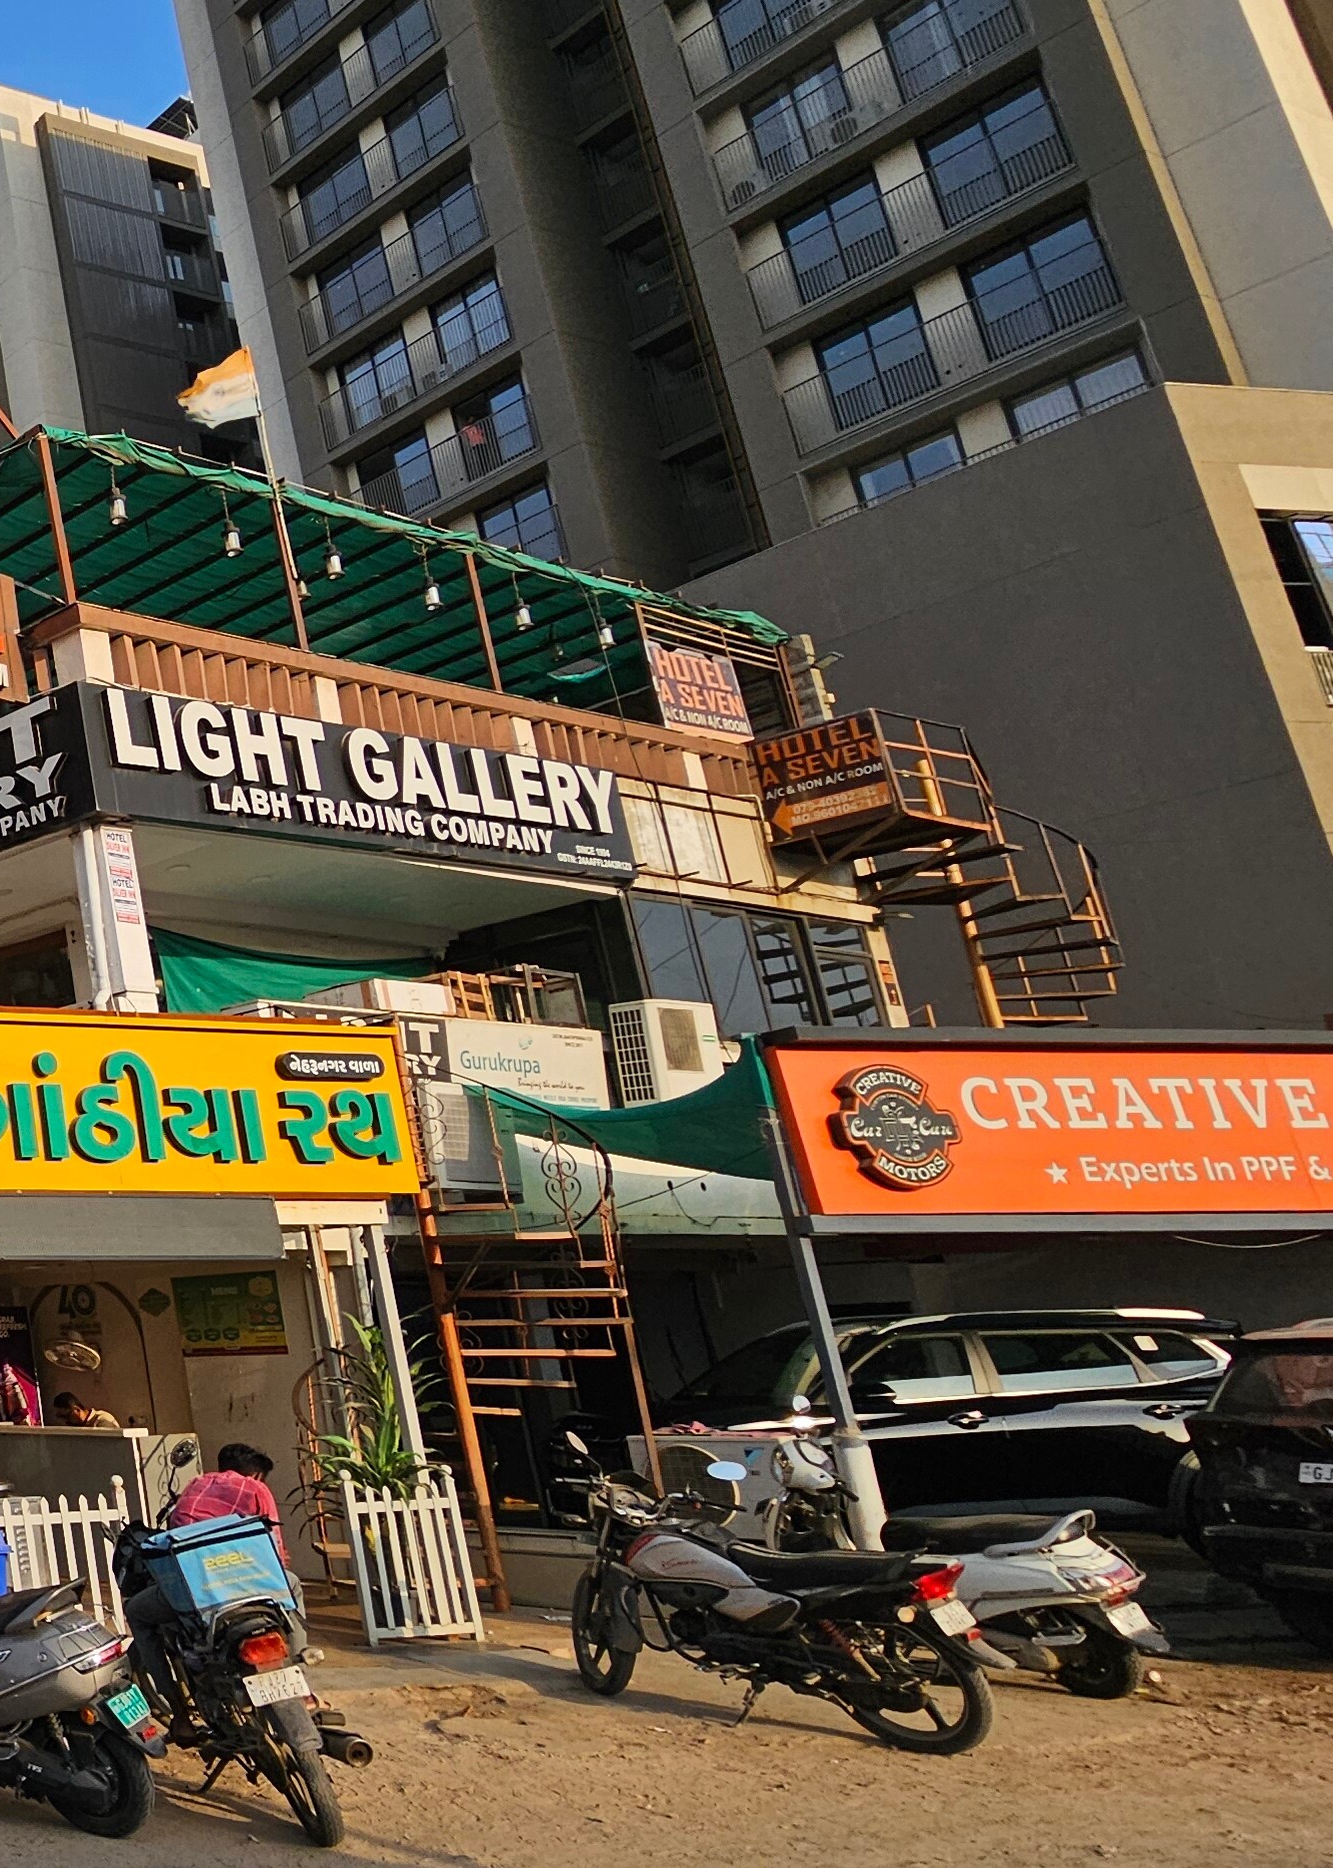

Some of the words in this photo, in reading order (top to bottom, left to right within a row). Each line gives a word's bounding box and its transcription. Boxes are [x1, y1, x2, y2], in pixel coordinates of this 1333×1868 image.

[653, 650, 733, 693] HOTEL
[659, 679, 675, 704] A
[677, 683, 745, 719] SEVEN
[723, 717, 748, 734] ROOM
[755, 717, 872, 766] HOTEL
[105, 687, 325, 792] LIGHT
[345, 726, 614, 836] GALLERY
[762, 768, 780, 788] A
[788, 738, 882, 780] SEVEN
[765, 781, 786, 801] A/C
[786, 785, 796, 796] &
[797, 777, 823, 793] NON
[825, 770, 846, 788] A/C
[846, 762, 884, 779] ROOM
[106, 832, 127, 844] HOTEL
[210, 782, 292, 819] LABH
[296, 794, 425, 836] TRADING
[430, 812, 554, 856] COMPANY
[112, 878, 134, 889] HOTEL
[348, 1057, 381, 1076] વાળા
[460, 1050, 541, 1078] Gurukrupa
[855, 1071, 922, 1095] CREATIVE
[960, 1077, 1330, 1131] CREATIVE
[278, 1089, 404, 1165] રથ
[879, 1156, 947, 1181] MOTORS
[1079, 1156, 1199, 1190] Experts
[1203, 1156, 1235, 1181] In
[1244, 1156, 1296, 1182] PPF
[1308, 1158, 1331, 1182] &
